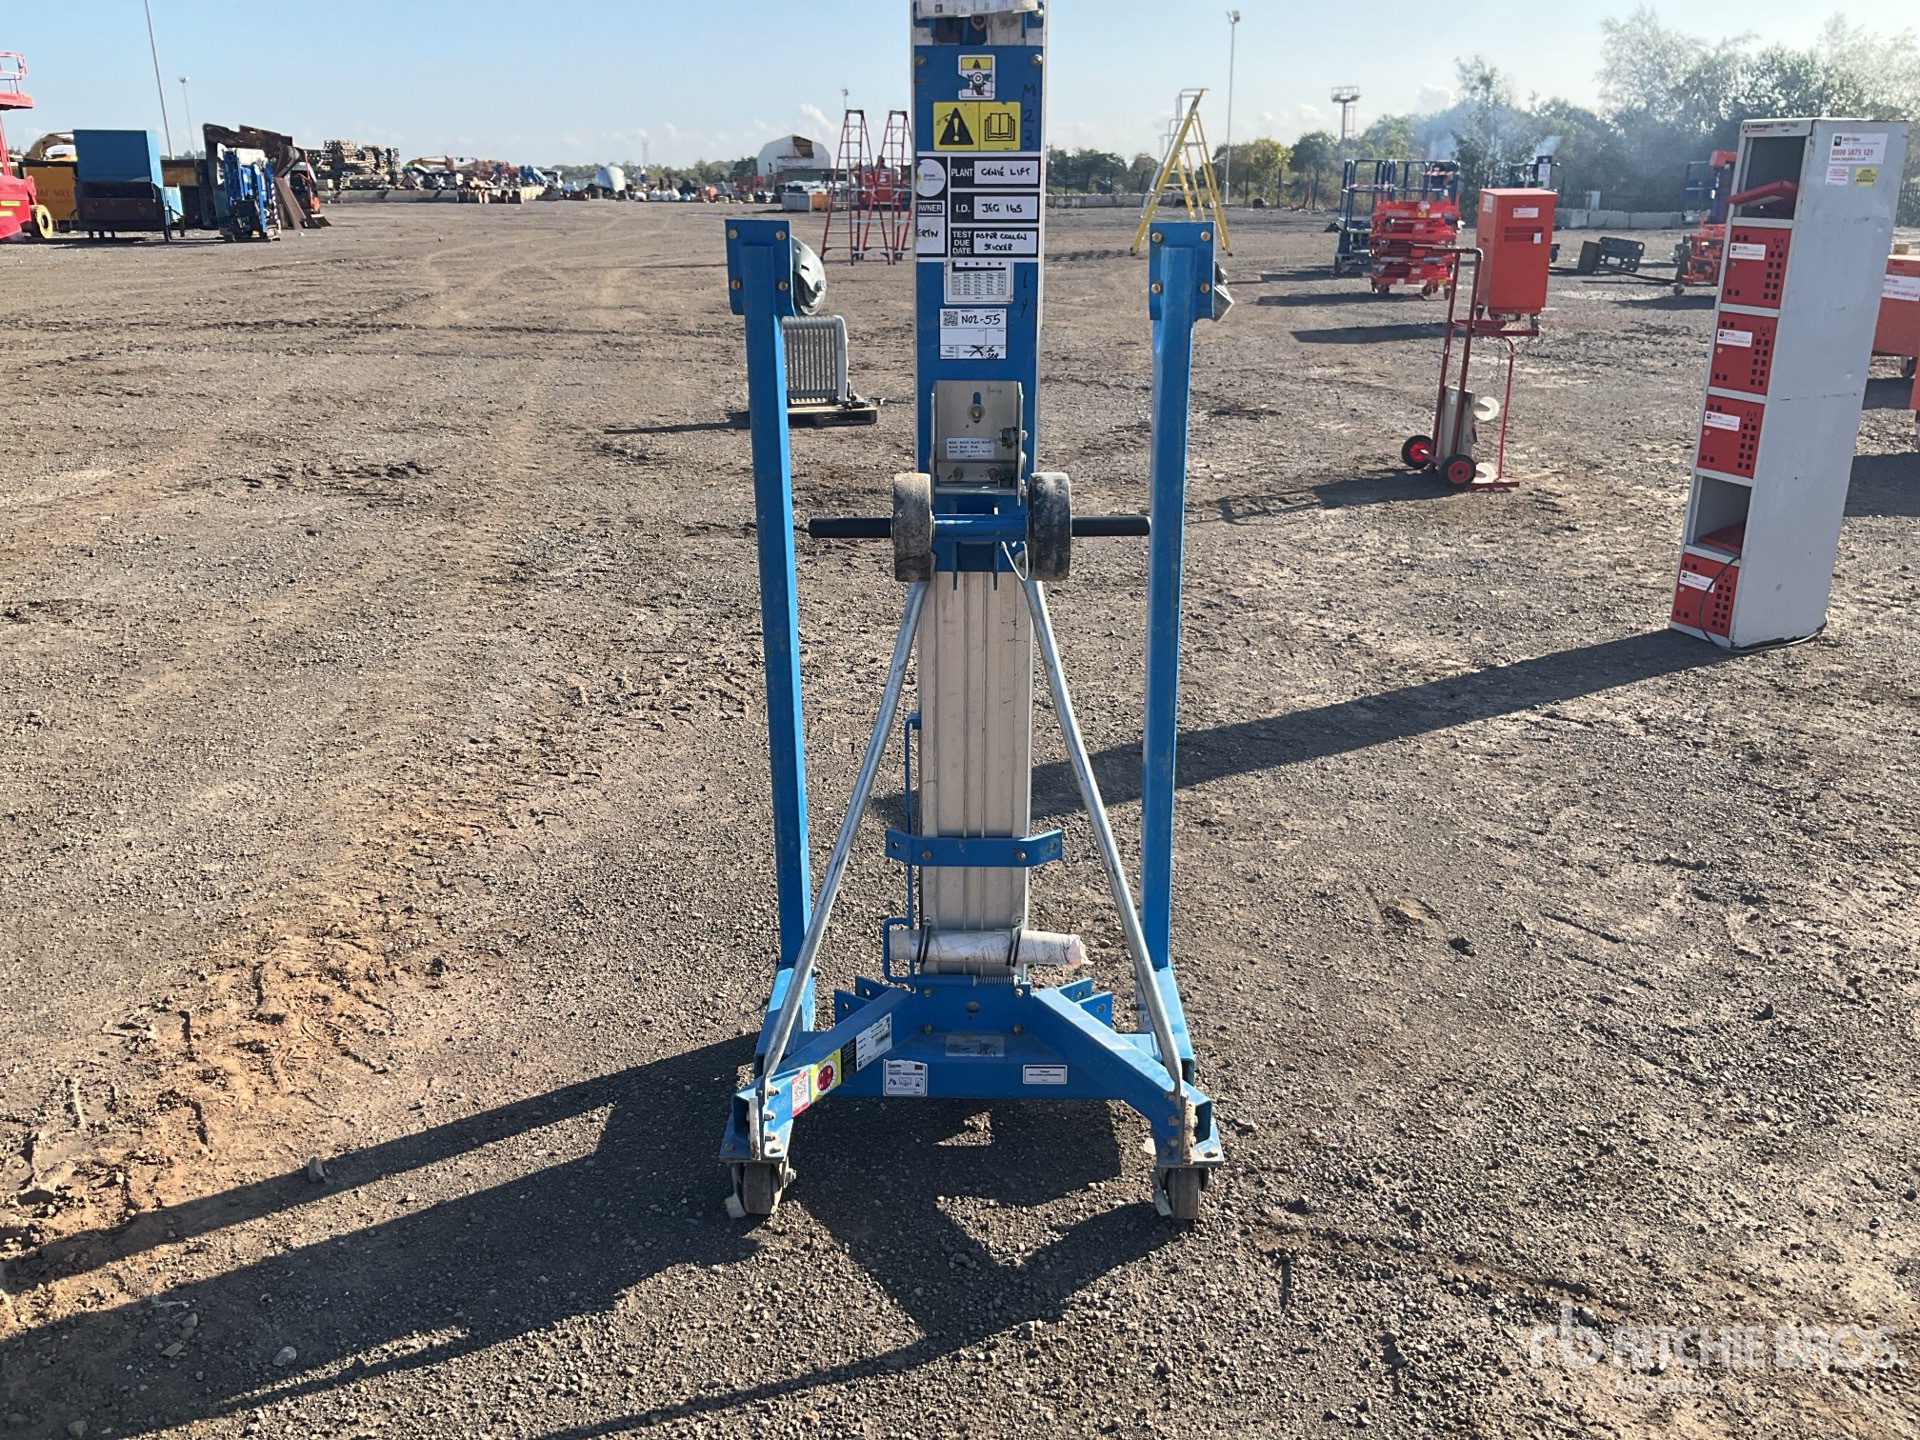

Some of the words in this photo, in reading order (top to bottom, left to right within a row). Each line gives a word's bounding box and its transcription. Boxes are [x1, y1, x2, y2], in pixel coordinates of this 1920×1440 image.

[951, 168, 973, 177] PLANT
[1010, 167, 1031, 176] LIFT
[955, 204, 971, 213] I.D.
[952, 230, 972, 238] TEST
[953, 239, 971, 247] DUE
[952, 247, 972, 255] DATE
